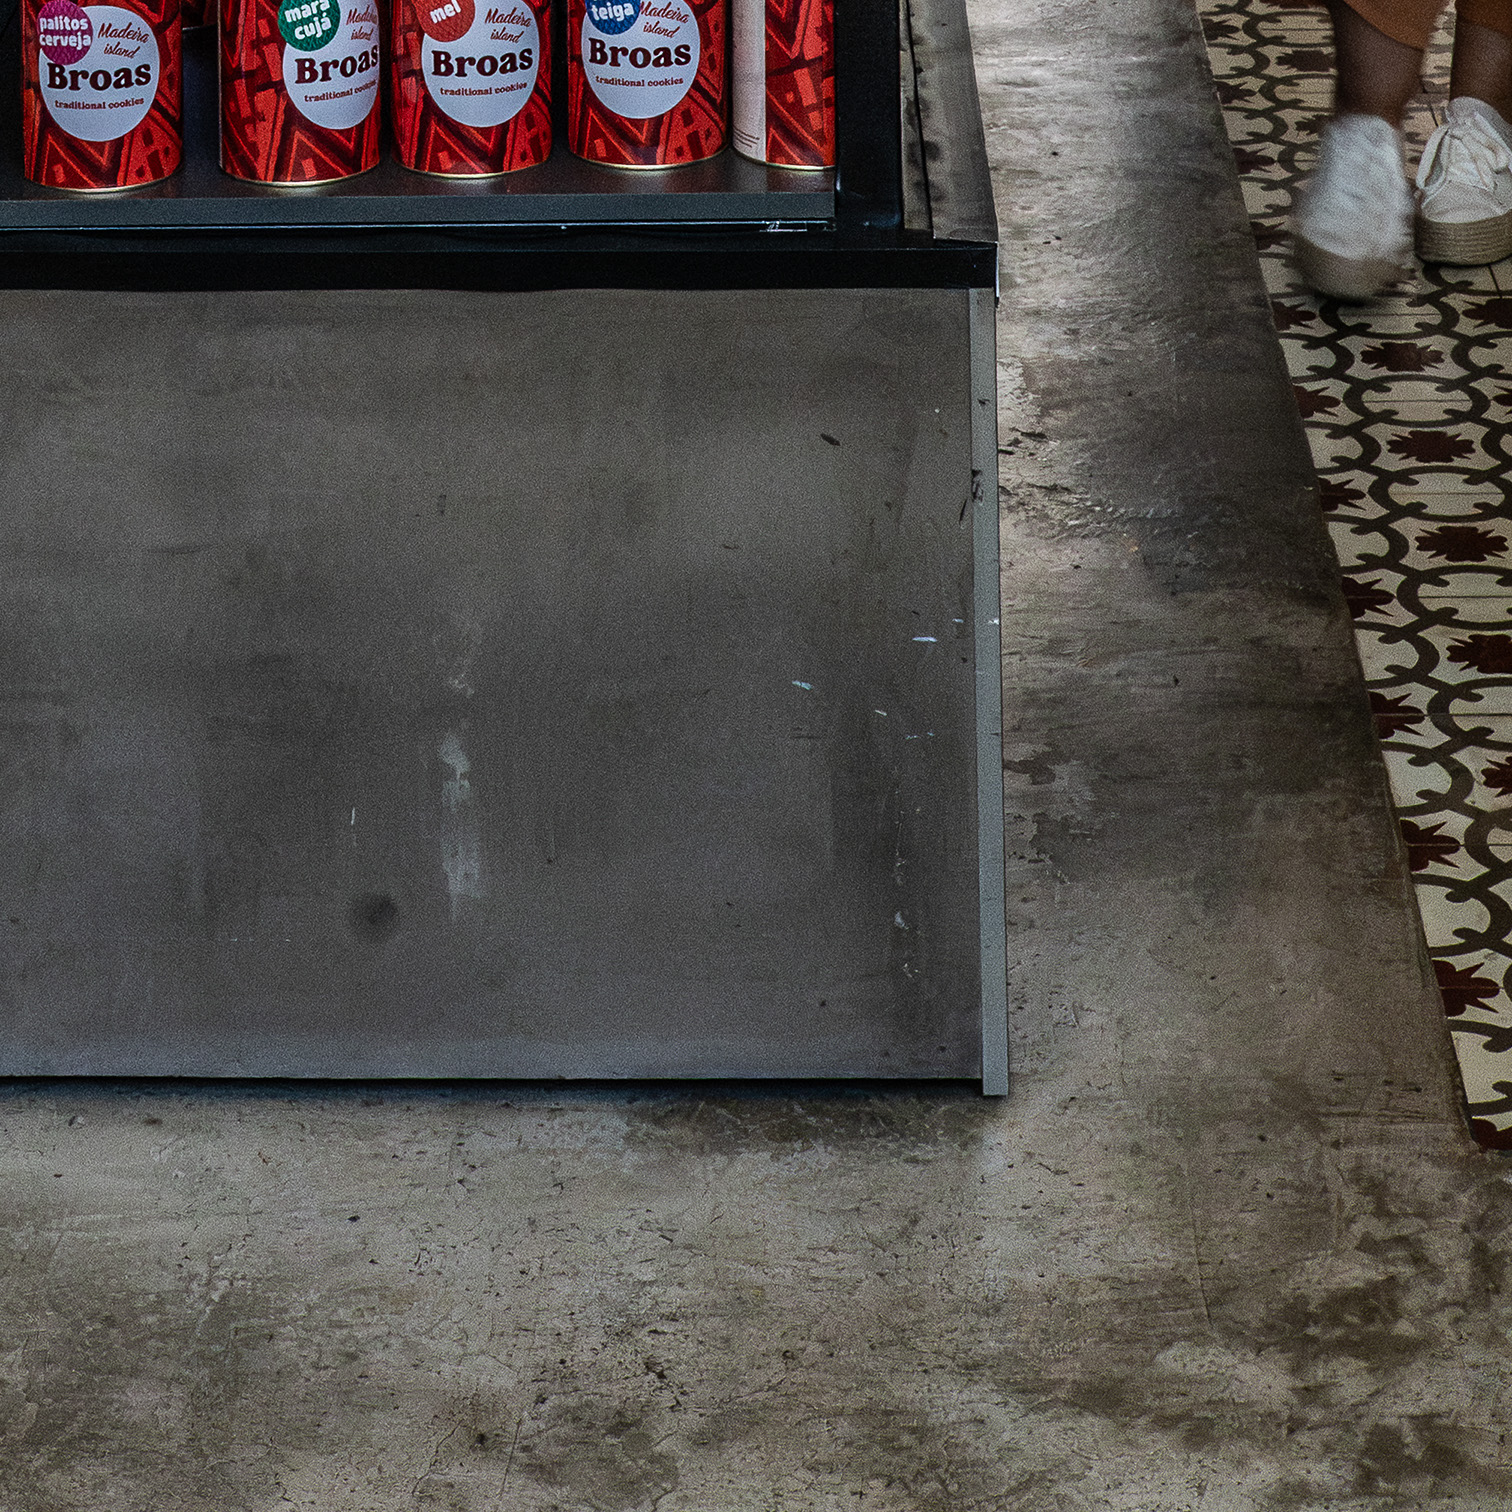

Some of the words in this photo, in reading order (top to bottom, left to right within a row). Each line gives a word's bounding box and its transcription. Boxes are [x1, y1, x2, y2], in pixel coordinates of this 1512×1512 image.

[485, 7, 531, 27] Madeira
[591, 2, 634, 22] teiga
[640, 1, 689, 23] Madeira
[40, 15, 88, 32] palitos
[98, 22, 149, 43] Madeira
[295, 12, 331, 39] cujá
[643, 21, 680, 38] island
[39, 32, 91, 50] cerveja
[351, 26, 374, 41] island
[491, 27, 524, 43] island
[104, 42, 140, 59] island
[589, 38, 691, 68] Broas
[295, 45, 378, 84] Broas
[432, 48, 533, 77] Broas
[47, 63, 151, 91] Broas
[596, 76, 644, 86] traditional
[648, 78, 683, 86] cookies
[305, 89, 353, 102] traditional
[440, 88, 492, 96] traditional
[495, 82, 527, 94] cookies
[55, 100, 106, 109] traditional
[108, 98, 144, 109] cookies
